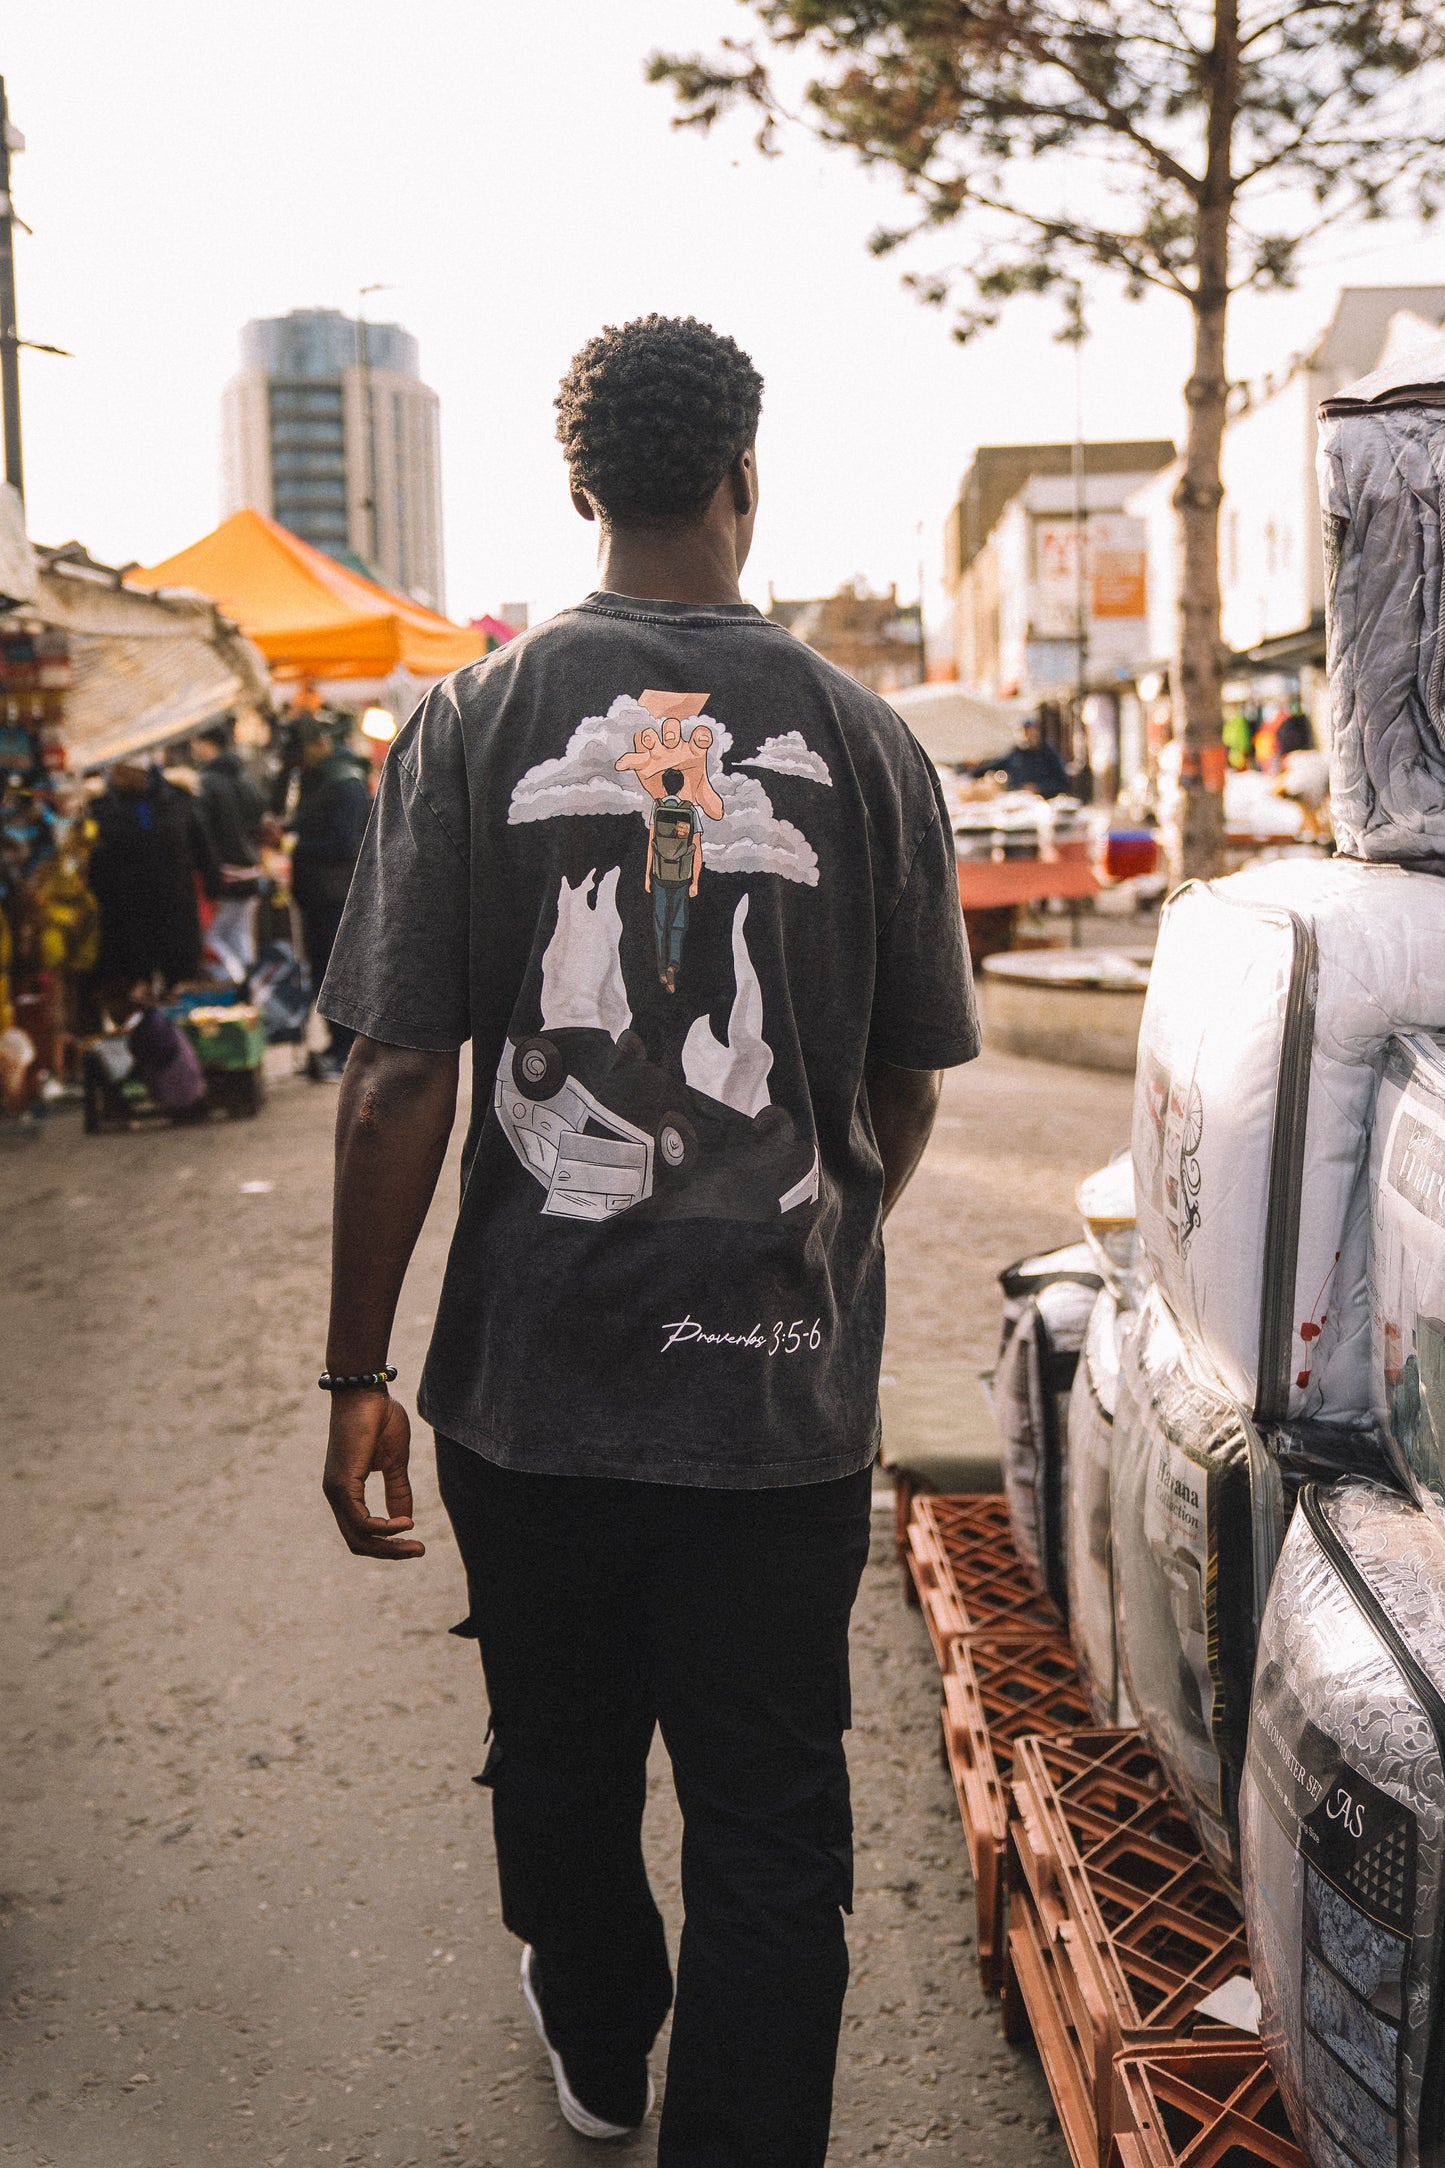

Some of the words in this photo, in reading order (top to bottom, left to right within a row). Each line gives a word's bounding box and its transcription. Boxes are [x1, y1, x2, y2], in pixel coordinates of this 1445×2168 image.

[661, 1314, 766, 1352] Proverbs
[768, 1318, 821, 1356] 3:5-6
[1155, 1484, 1199, 1529] Collection
[1267, 1720, 1306, 1786] COMFORTER
[1306, 1774, 1322, 1802] SET
[1326, 1788, 1365, 1838] AS
